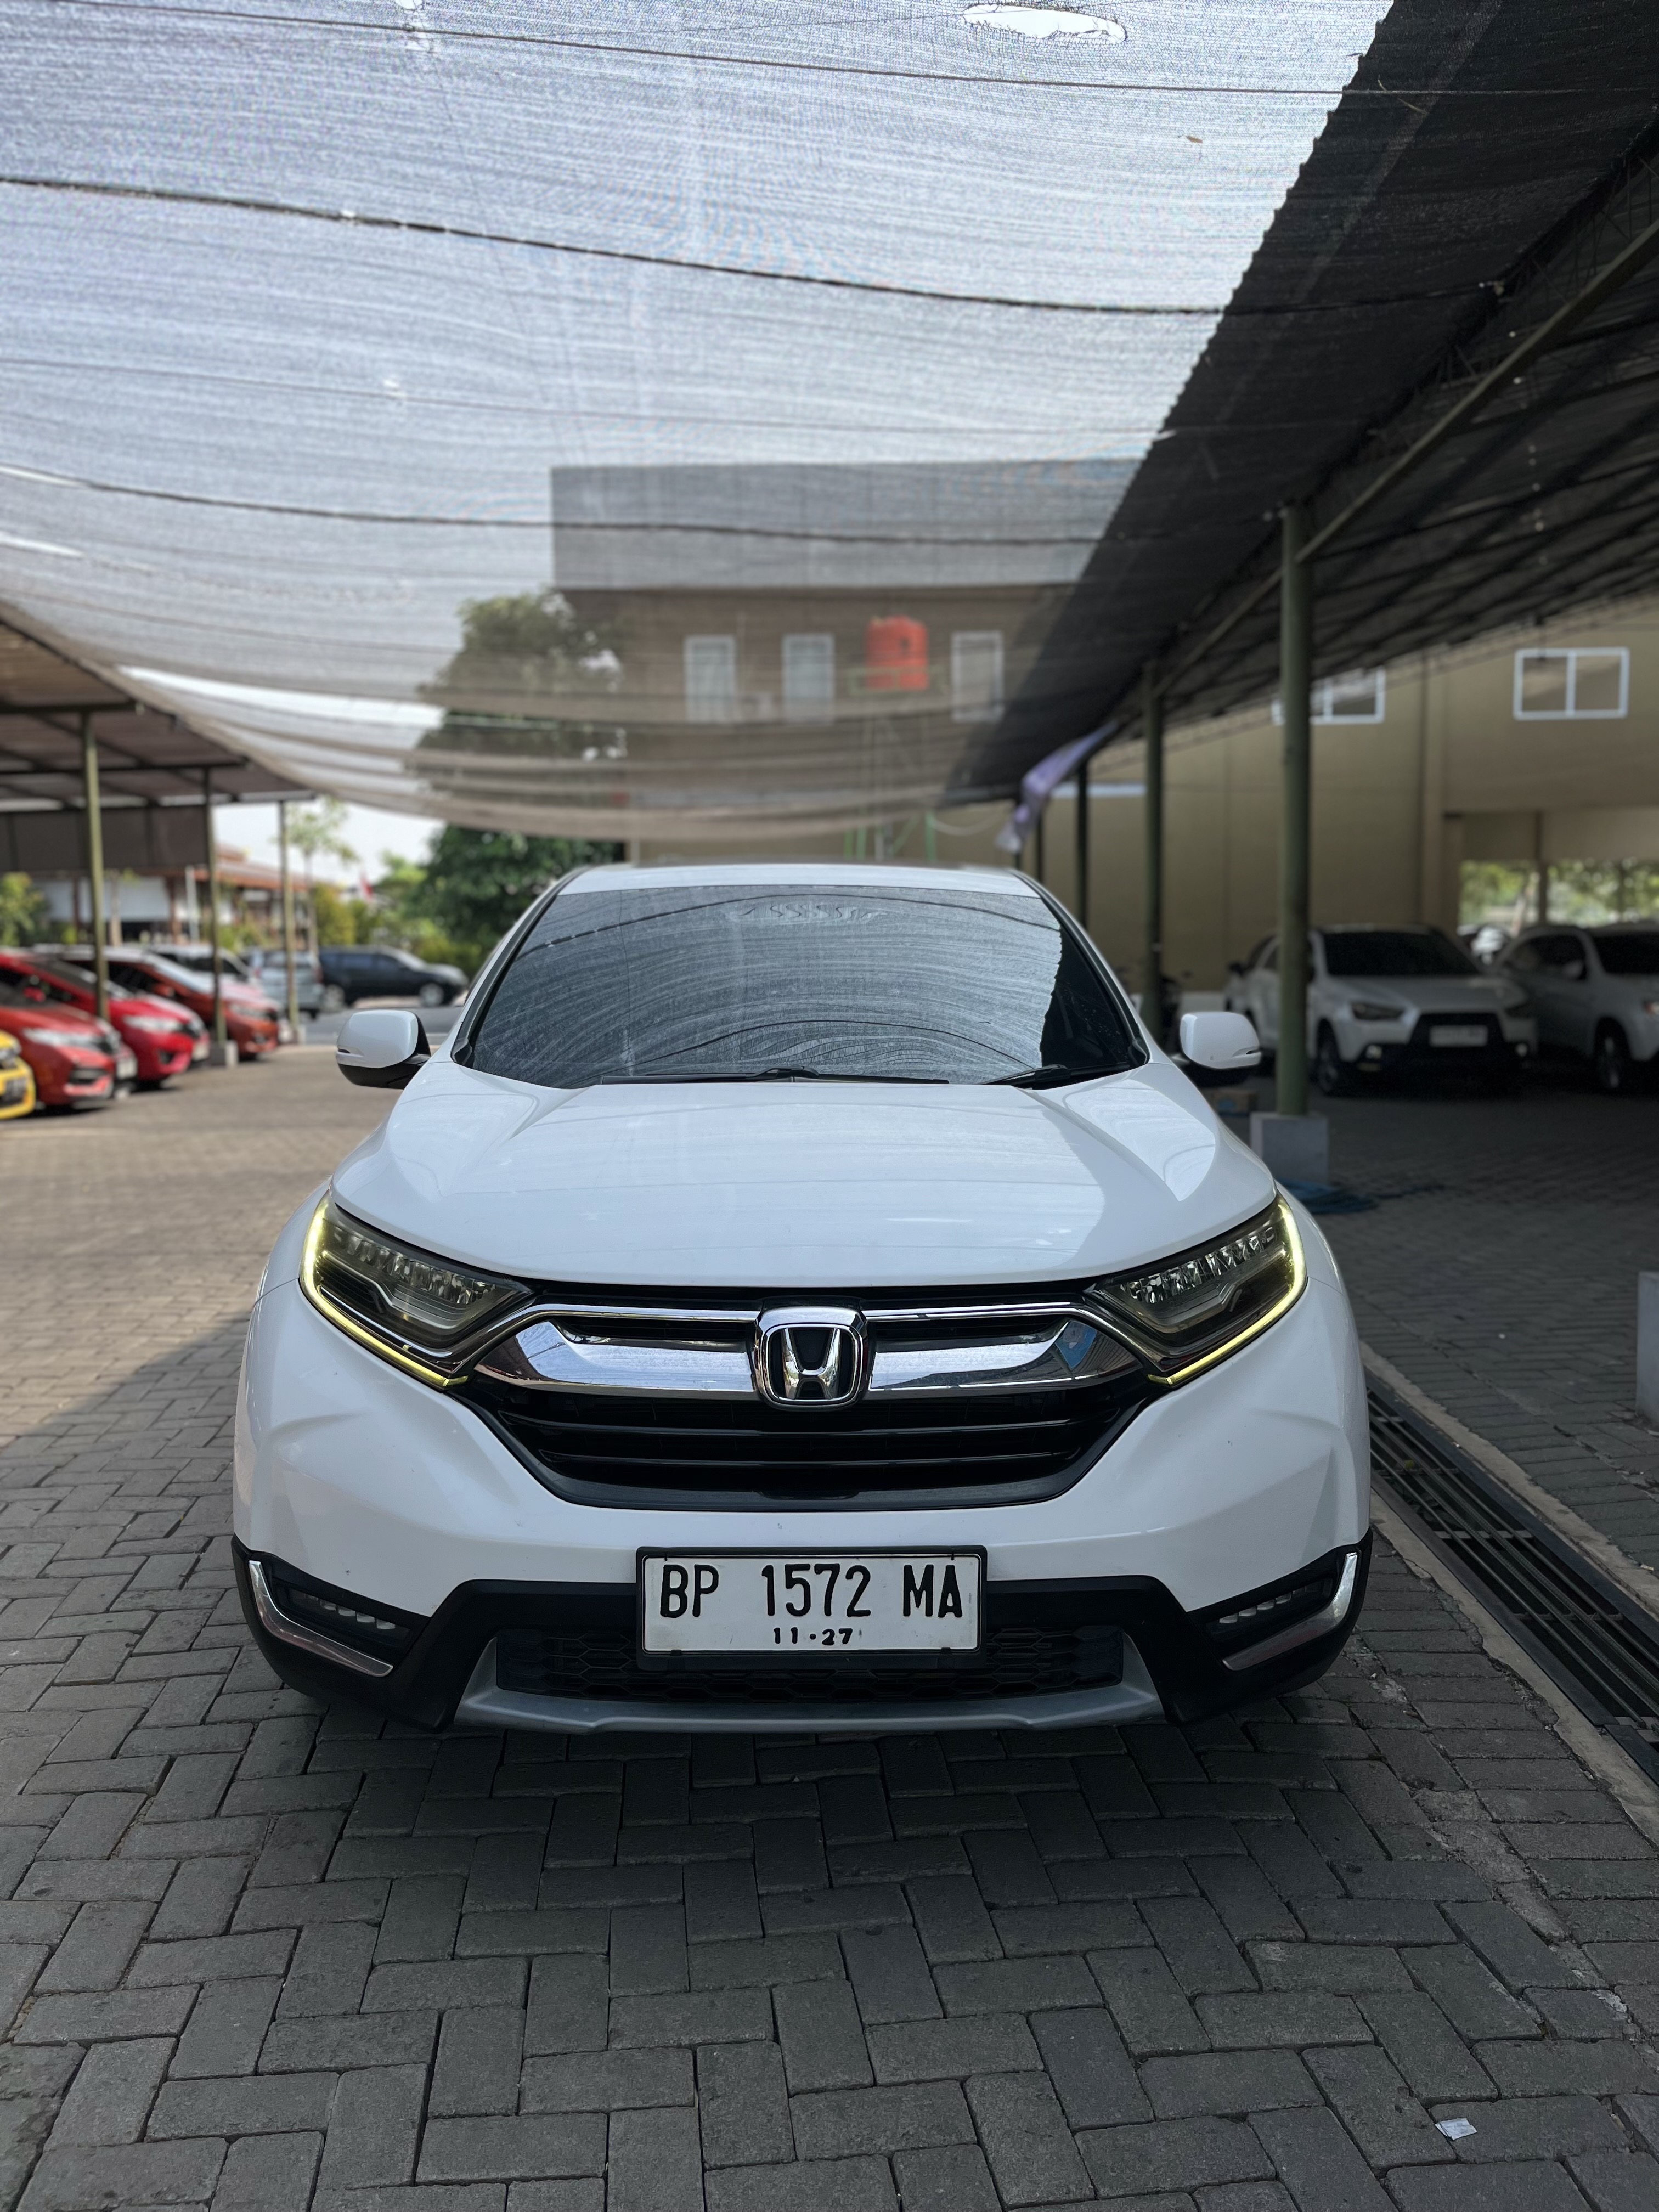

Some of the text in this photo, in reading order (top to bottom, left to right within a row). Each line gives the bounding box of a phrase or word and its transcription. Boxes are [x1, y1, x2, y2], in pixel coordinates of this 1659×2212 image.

[659, 1564, 720, 1618] BP
[760, 1563, 872, 1618] 1572
[902, 1564, 963, 1619] MA
